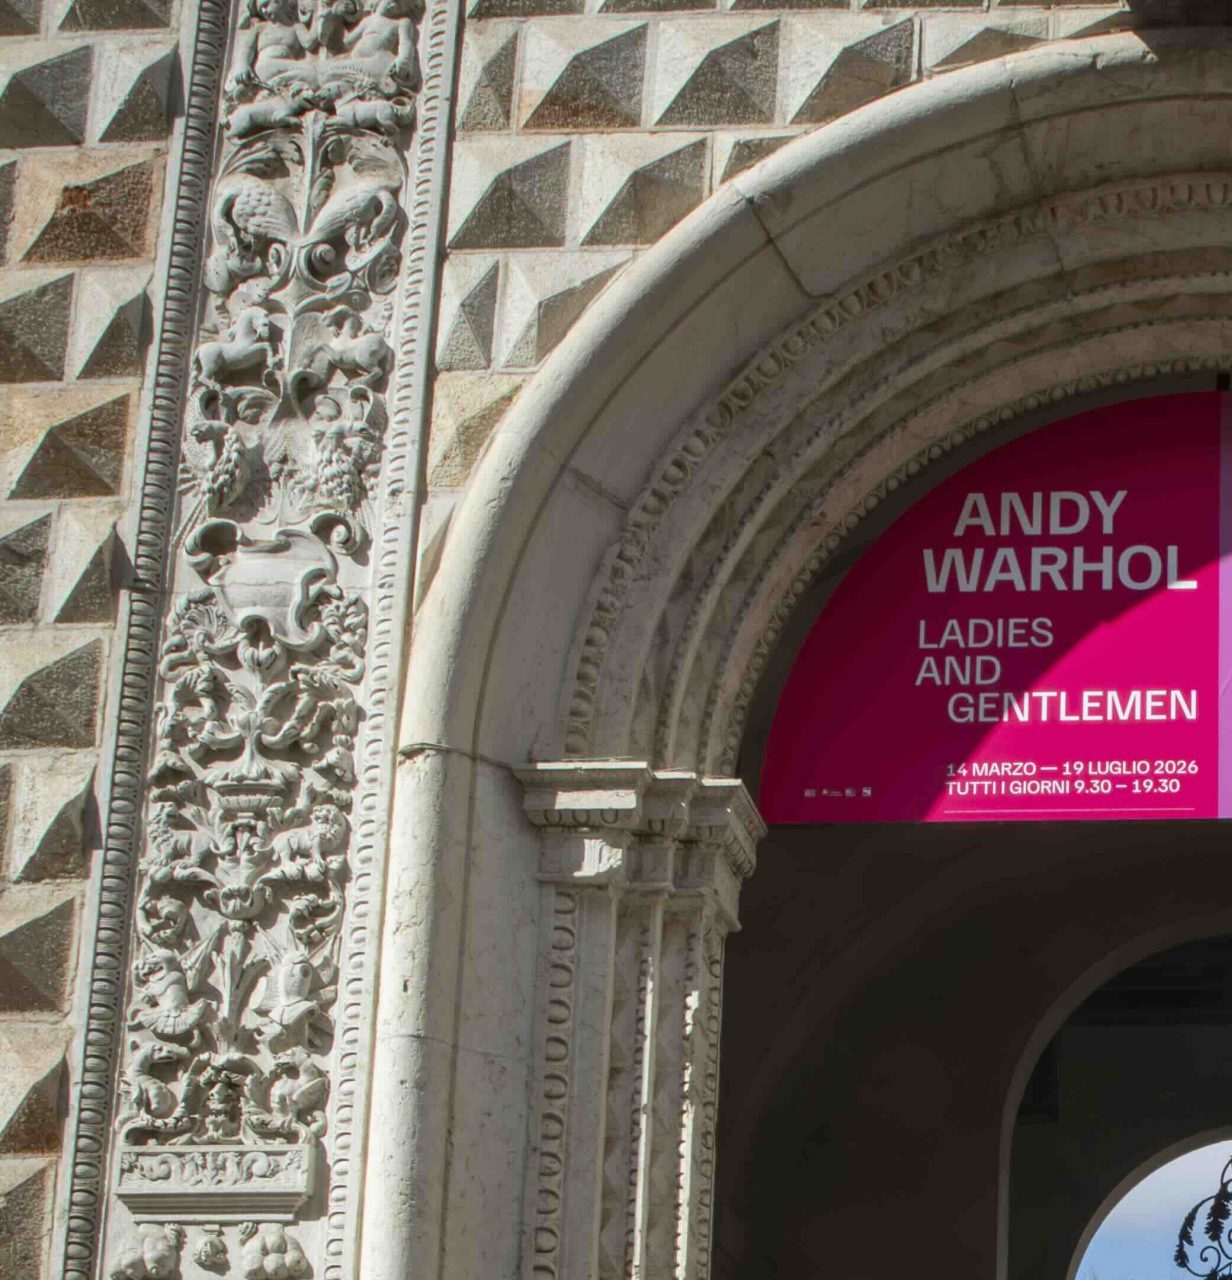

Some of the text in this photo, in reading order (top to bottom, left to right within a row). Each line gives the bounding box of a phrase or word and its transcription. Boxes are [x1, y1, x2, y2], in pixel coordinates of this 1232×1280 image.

[953, 490, 1128, 537] ANDY
[923, 544, 1199, 593] WARHOL
[918, 617, 1054, 649] LADIES
[915, 655, 1002, 686] AND
[947, 688, 1198, 724] GENTLEMEN
[946, 762, 967, 777] 14
[971, 761, 1037, 777] MARZO
[1062, 761, 1084, 776] 19
[1088, 760, 1150, 776] LUGLIO
[1153, 759, 1199, 775] 2026
[946, 780, 997, 796] TUTTI
[1001, 780, 1006, 795] I
[1009, 779, 1070, 795] GIORNI
[1074, 779, 1112, 795] 9.30
[1132, 778, 1181, 794] 19.30
